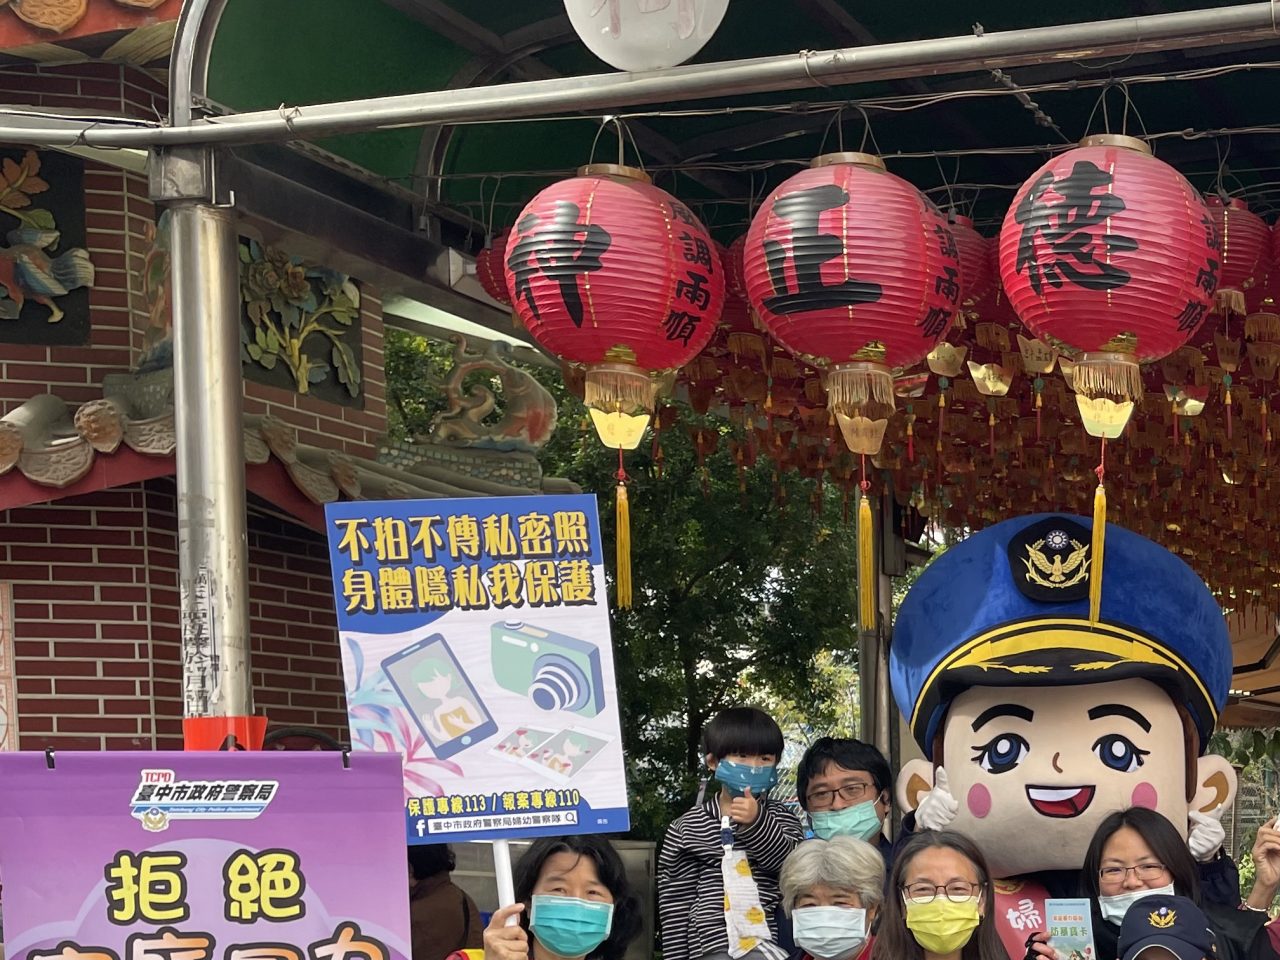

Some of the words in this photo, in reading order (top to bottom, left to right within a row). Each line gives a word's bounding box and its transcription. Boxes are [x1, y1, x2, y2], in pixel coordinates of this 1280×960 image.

[763, 185, 882, 316] 正
[1015, 160, 1139, 295] 德
[334, 511, 590, 563] 不拍不傳私密照
[342, 560, 596, 612] 身體隱私我保護
[136, 784, 275, 801] 臺中市政府警察局
[145, 772, 172, 782] TCPD
[408, 796, 486, 817] 保護專線113
[503, 790, 580, 811] 報案專線110
[433, 814, 561, 831] 臺中市政府警察局婦幼警察隊
[106, 849, 306, 925] 拒絕
